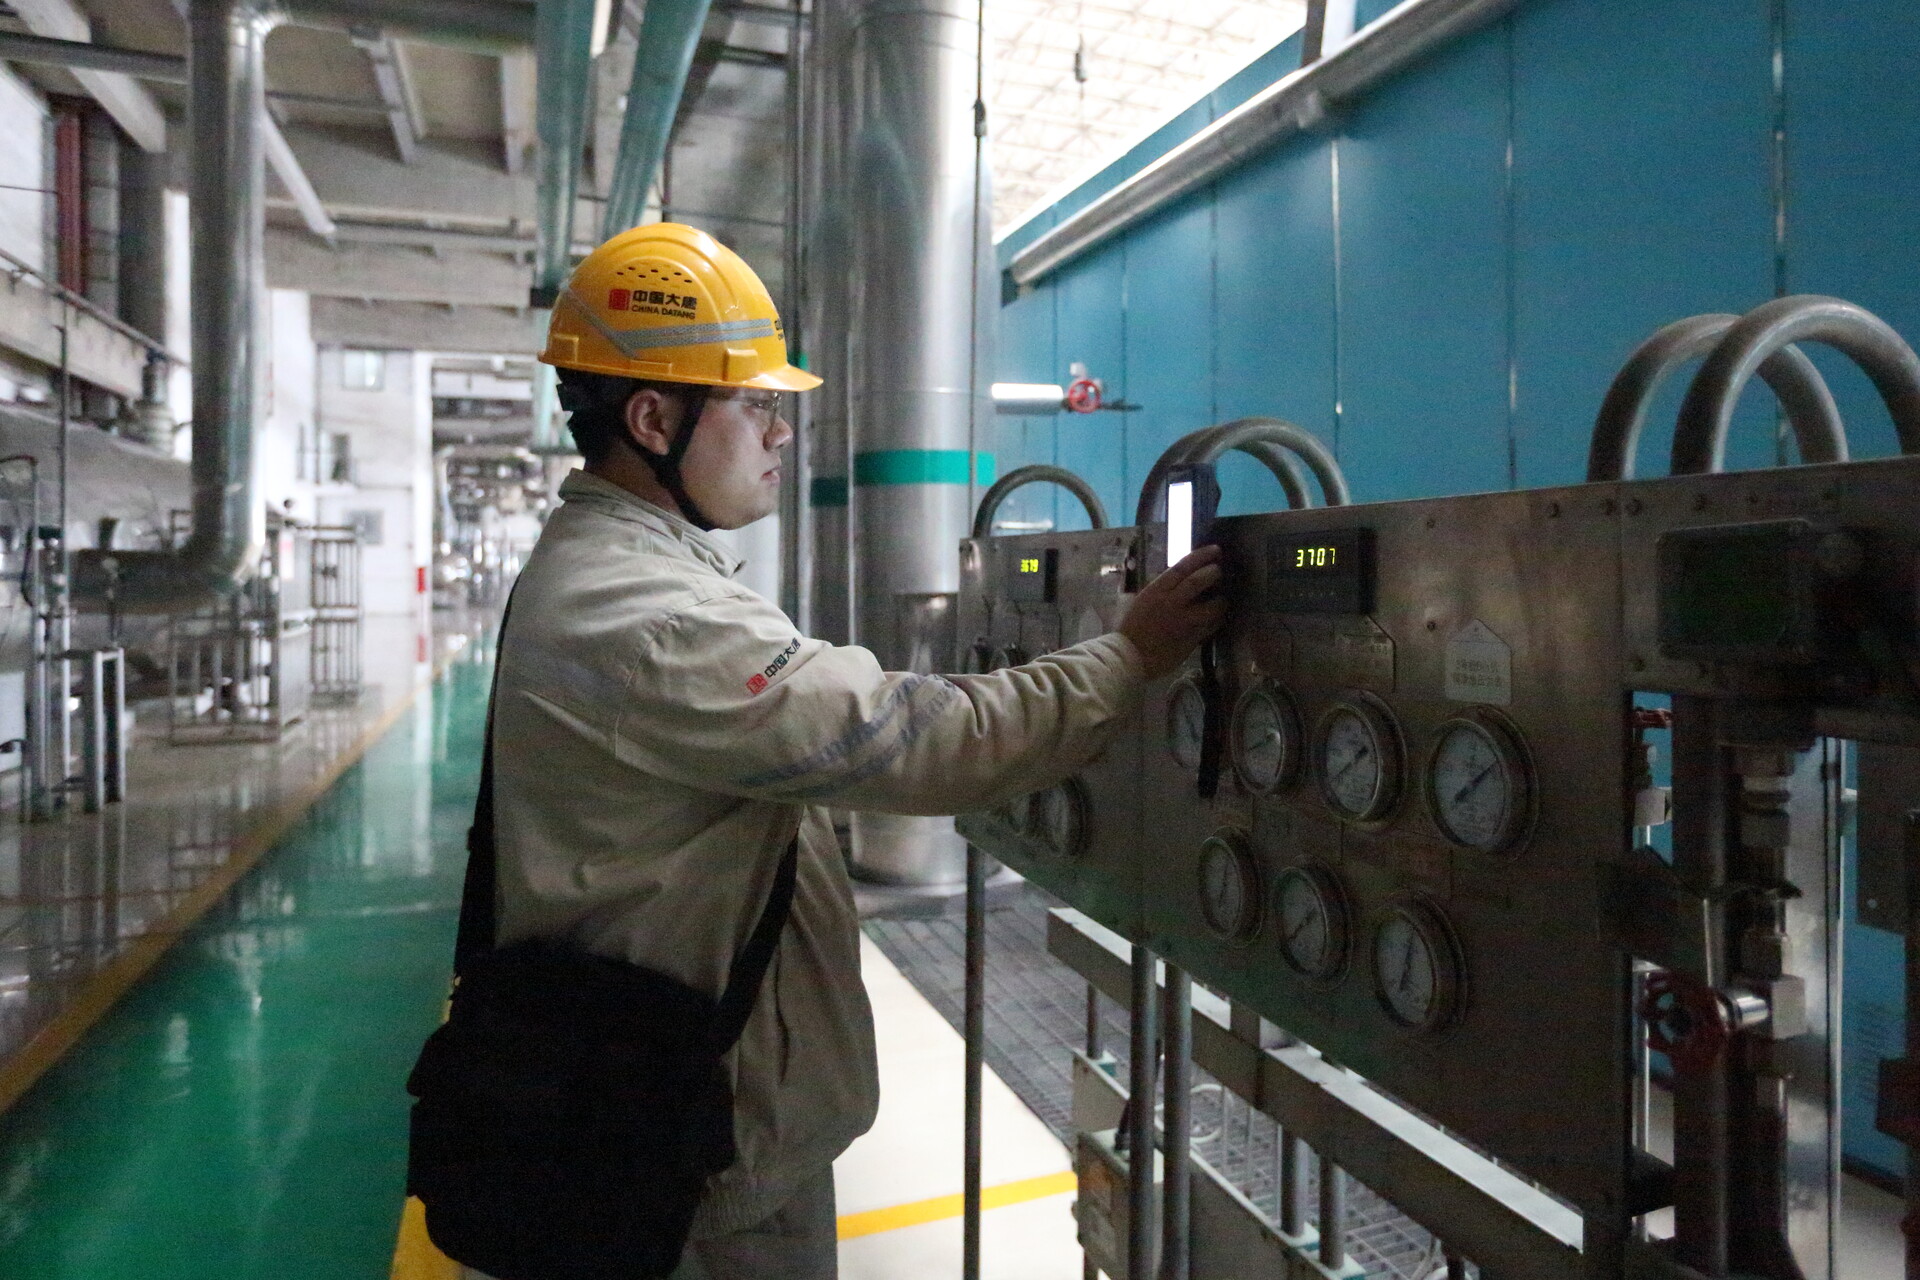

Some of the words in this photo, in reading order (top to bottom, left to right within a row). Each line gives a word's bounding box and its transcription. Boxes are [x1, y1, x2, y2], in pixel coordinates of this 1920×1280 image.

[633, 290, 697, 309] 中国大唐
[632, 305, 660, 315] CHINA
[661, 308, 696, 320] DATANG
[1296, 548, 1336, 568] 3707
[764, 637, 802, 678] 中国大唐
